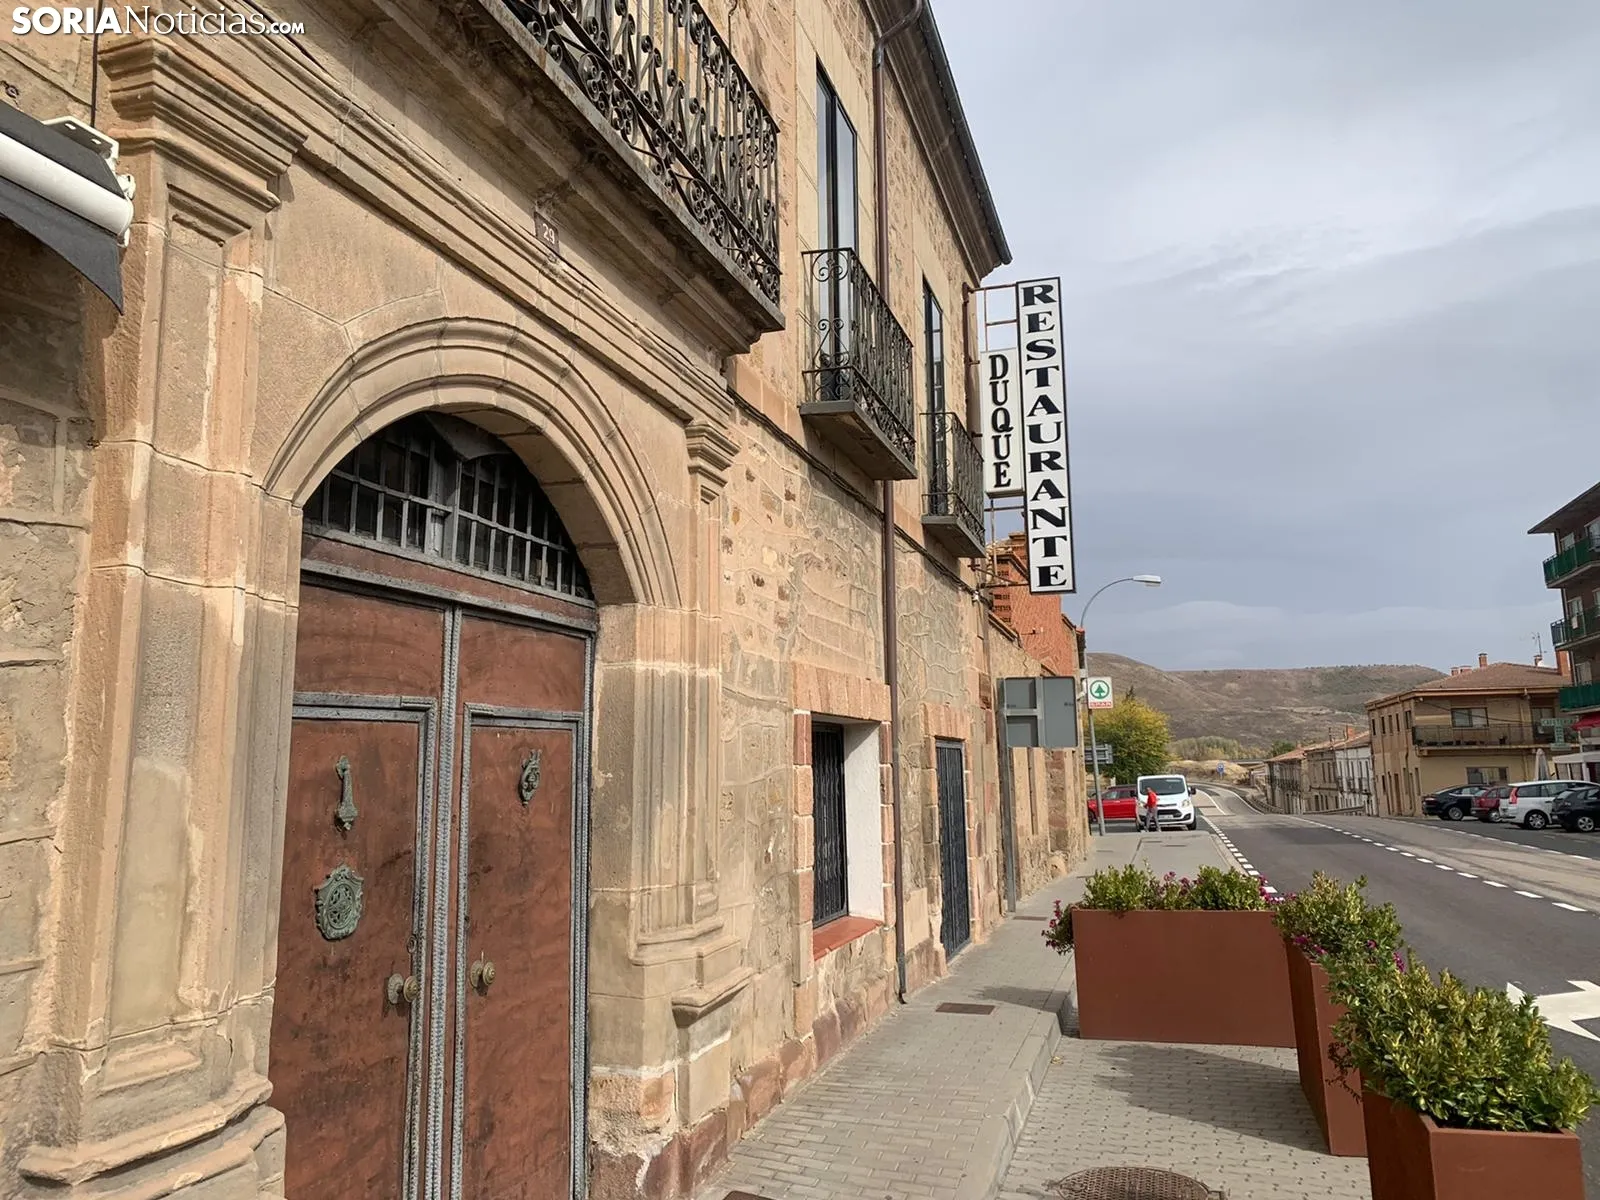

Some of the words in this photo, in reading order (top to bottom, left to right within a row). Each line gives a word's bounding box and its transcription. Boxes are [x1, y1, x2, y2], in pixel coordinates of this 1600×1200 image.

[541, 222, 556, 245] 29
[988, 353, 1014, 489] DUQUE
[1021, 284, 1068, 588] RESTAURANTE
